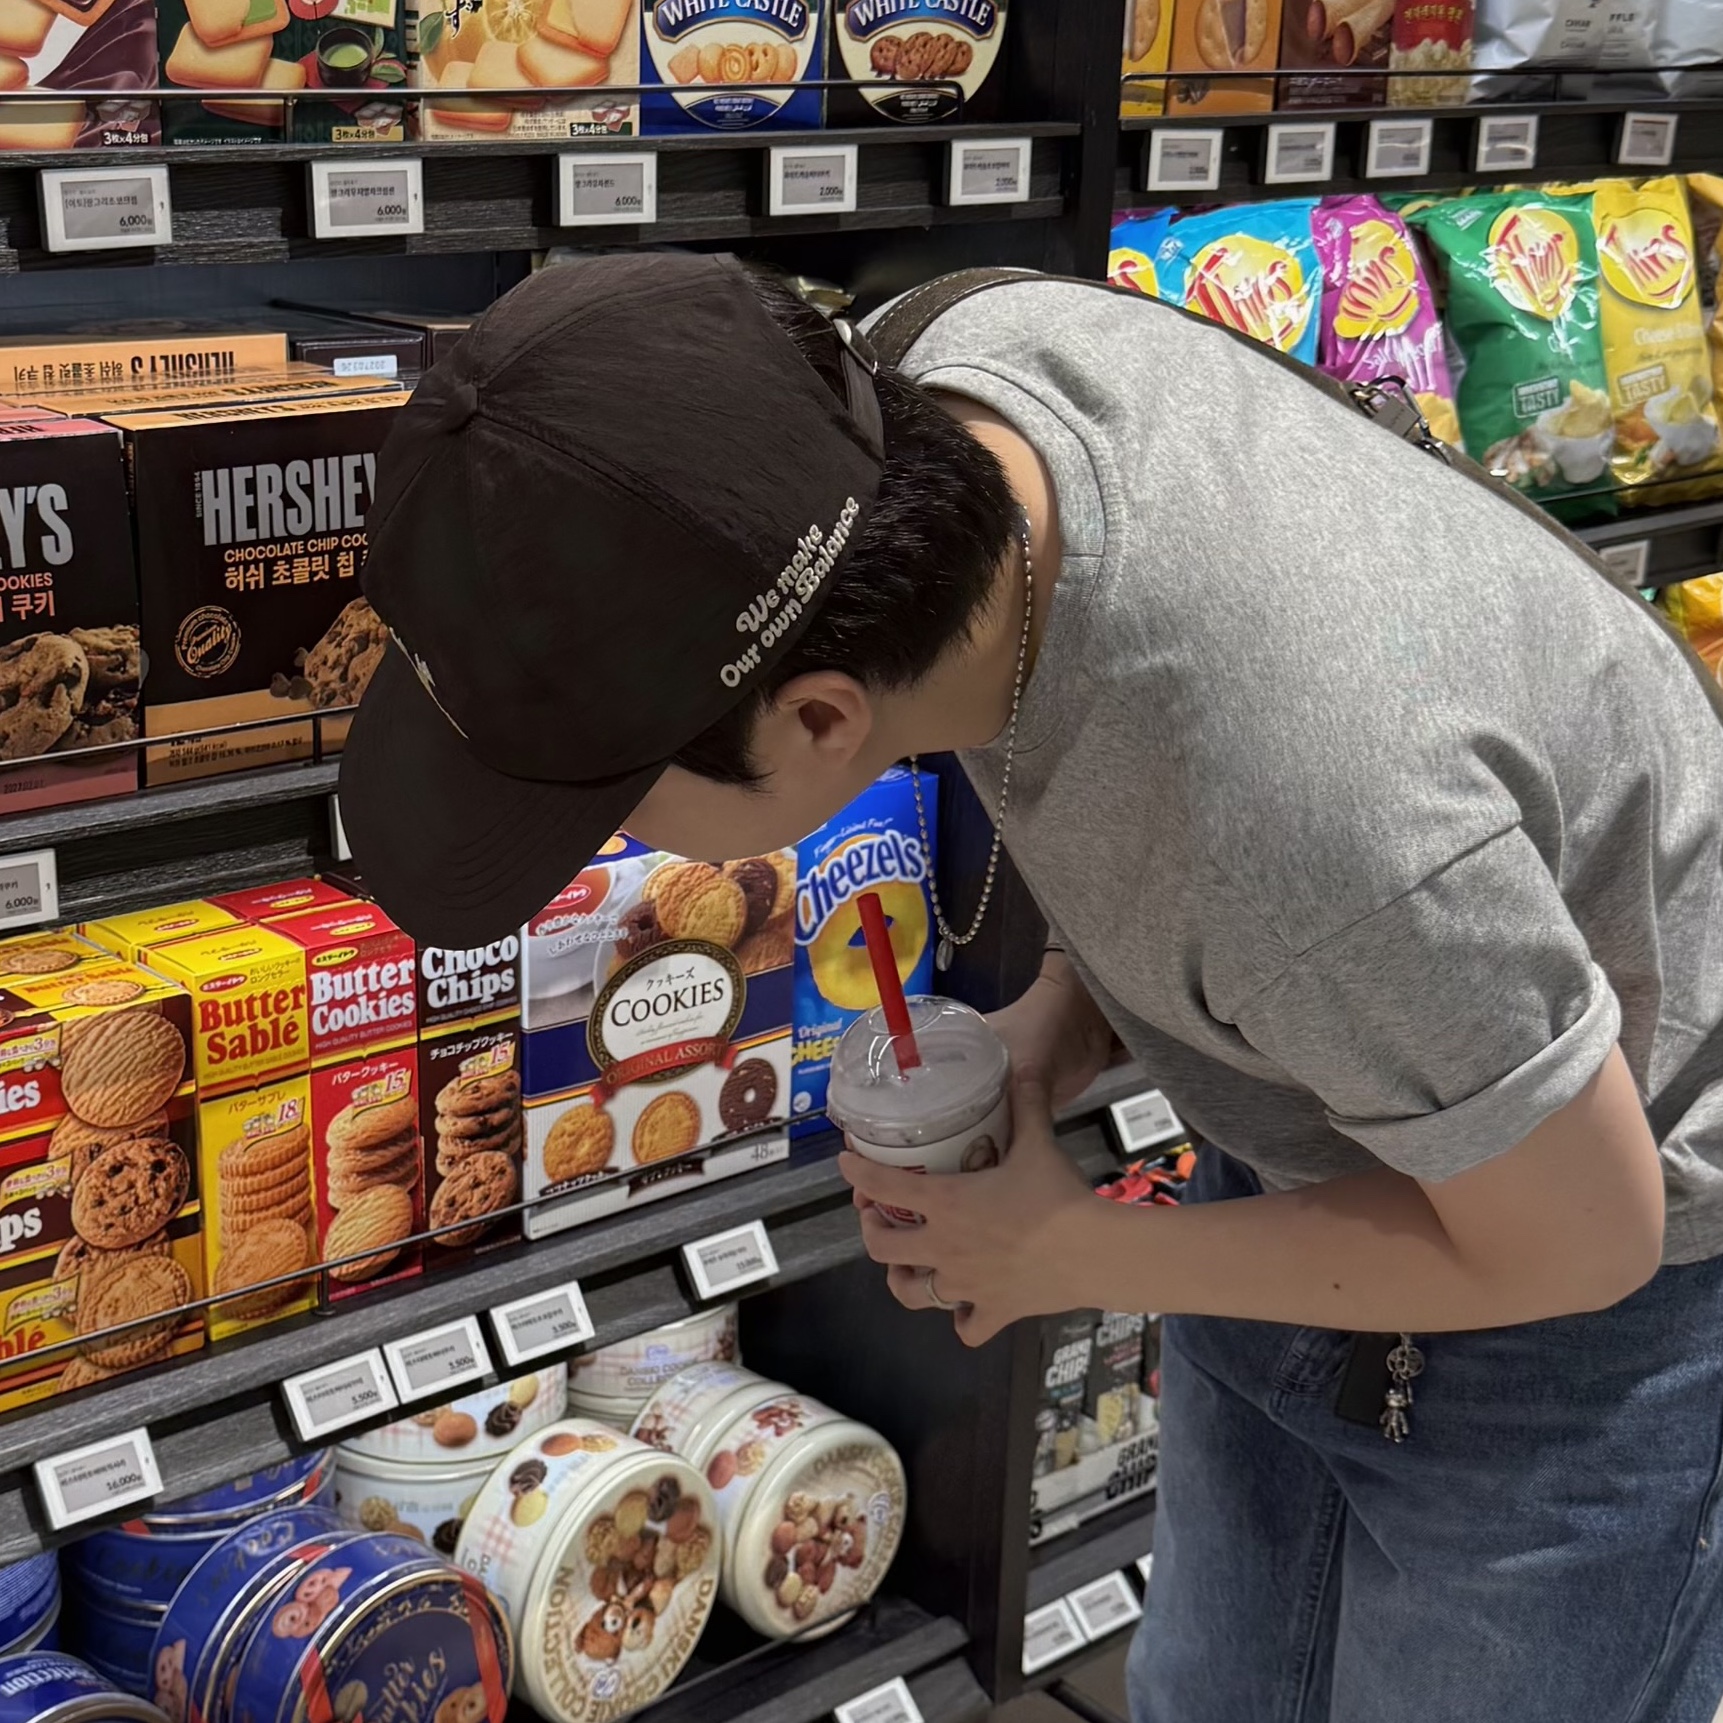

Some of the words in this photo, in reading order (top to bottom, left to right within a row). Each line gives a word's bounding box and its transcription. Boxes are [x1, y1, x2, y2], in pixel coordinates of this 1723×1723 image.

[1520, 390, 1560, 413] TASTY
[1624, 375, 1667, 401] TASTY
[0, 482, 75, 571] Y'S
[223, 540, 305, 563] CHOCOLATE
[306, 536, 340, 554] CHIP
[224, 561, 266, 592] 허쉬
[271, 553, 331, 586] 초콜릿
[335, 549, 355, 579] 칩
[735, 594, 780, 633] We
[776, 523, 823, 595] make
[11, 589, 56, 621] 쿠키
[719, 642, 762, 688] Our
[760, 598, 803, 648] own
[794, 496, 860, 605] Balance
[186, 622, 233, 665] Quality
[794, 829, 927, 942] Cheezels
[421, 934, 520, 980] Choco
[310, 958, 416, 1006] Butter
[426, 966, 516, 1009] Chips
[645, 966, 696, 992] クッキーズ
[198, 983, 306, 1034] Butter
[312, 990, 416, 1036] Cookies
[610, 977, 724, 1028] COOKIES
[206, 1014, 301, 1066] Sablé
[430, 1031, 515, 1061] チョコチップクッキー
[797, 1018, 843, 1040] Original
[331, 1061, 400, 1086] バタークッキー
[605, 1051, 674, 1086] ORIGINAL
[227, 1090, 286, 1115] バターサブレ
[278, 1098, 299, 1123] 18
[1095, 1316, 1144, 1348] CHIPS
[1044, 1359, 1089, 1389] CHIPS
